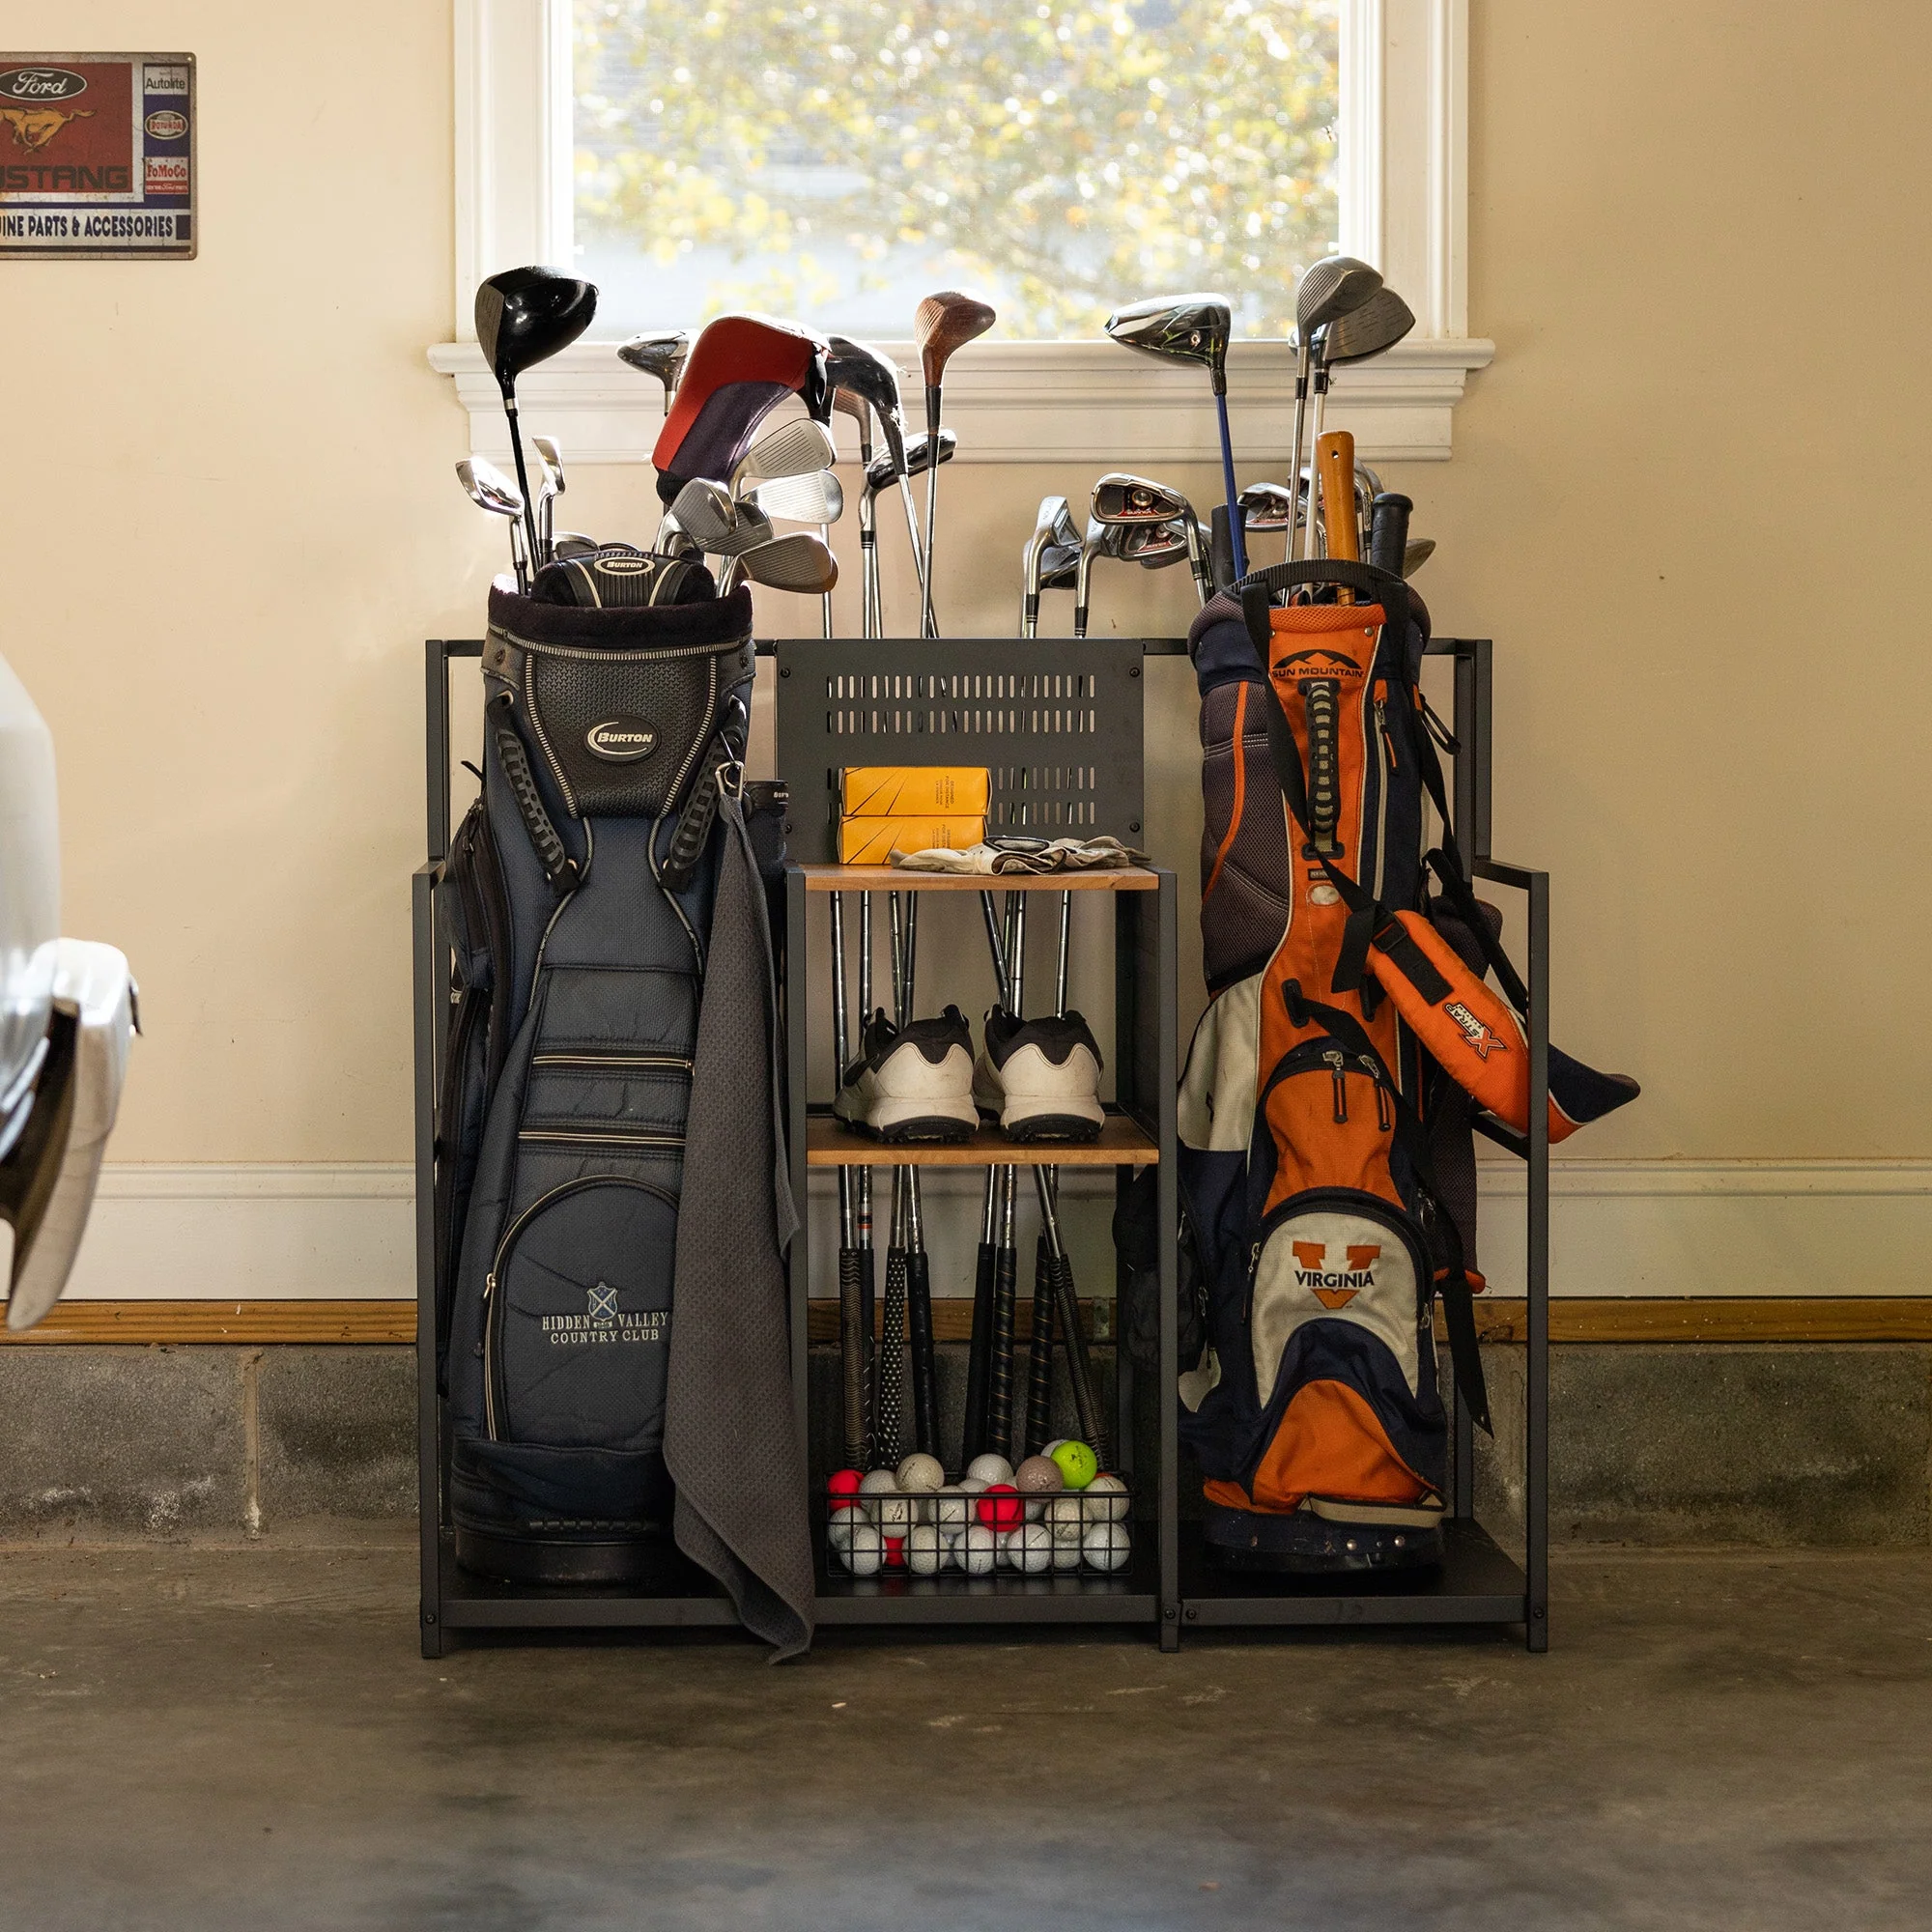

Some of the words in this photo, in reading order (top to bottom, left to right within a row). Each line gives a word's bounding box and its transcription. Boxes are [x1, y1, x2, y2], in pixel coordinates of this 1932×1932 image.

[13, 71, 67, 95] Ford
[146, 77, 185, 90] Autolite
[0, 165, 128, 189] STANG
[147, 164, 186, 178] FoMoCo
[28, 215, 68, 237] PARTS
[71, 216, 80, 237] &
[84, 215, 173, 237] ACCESSORIES
[1272, 668, 1295, 678] SUN
[1298, 668, 1364, 678] MOUNTAIN
[1294, 1270, 1375, 1288] VIRGINIA
[542, 1315, 590, 1330] HIDDEN
[618, 1312, 668, 1327] VALLEY
[551, 1330, 618, 1344] COUNTRY
[622, 1329, 659, 1342] CLUB
